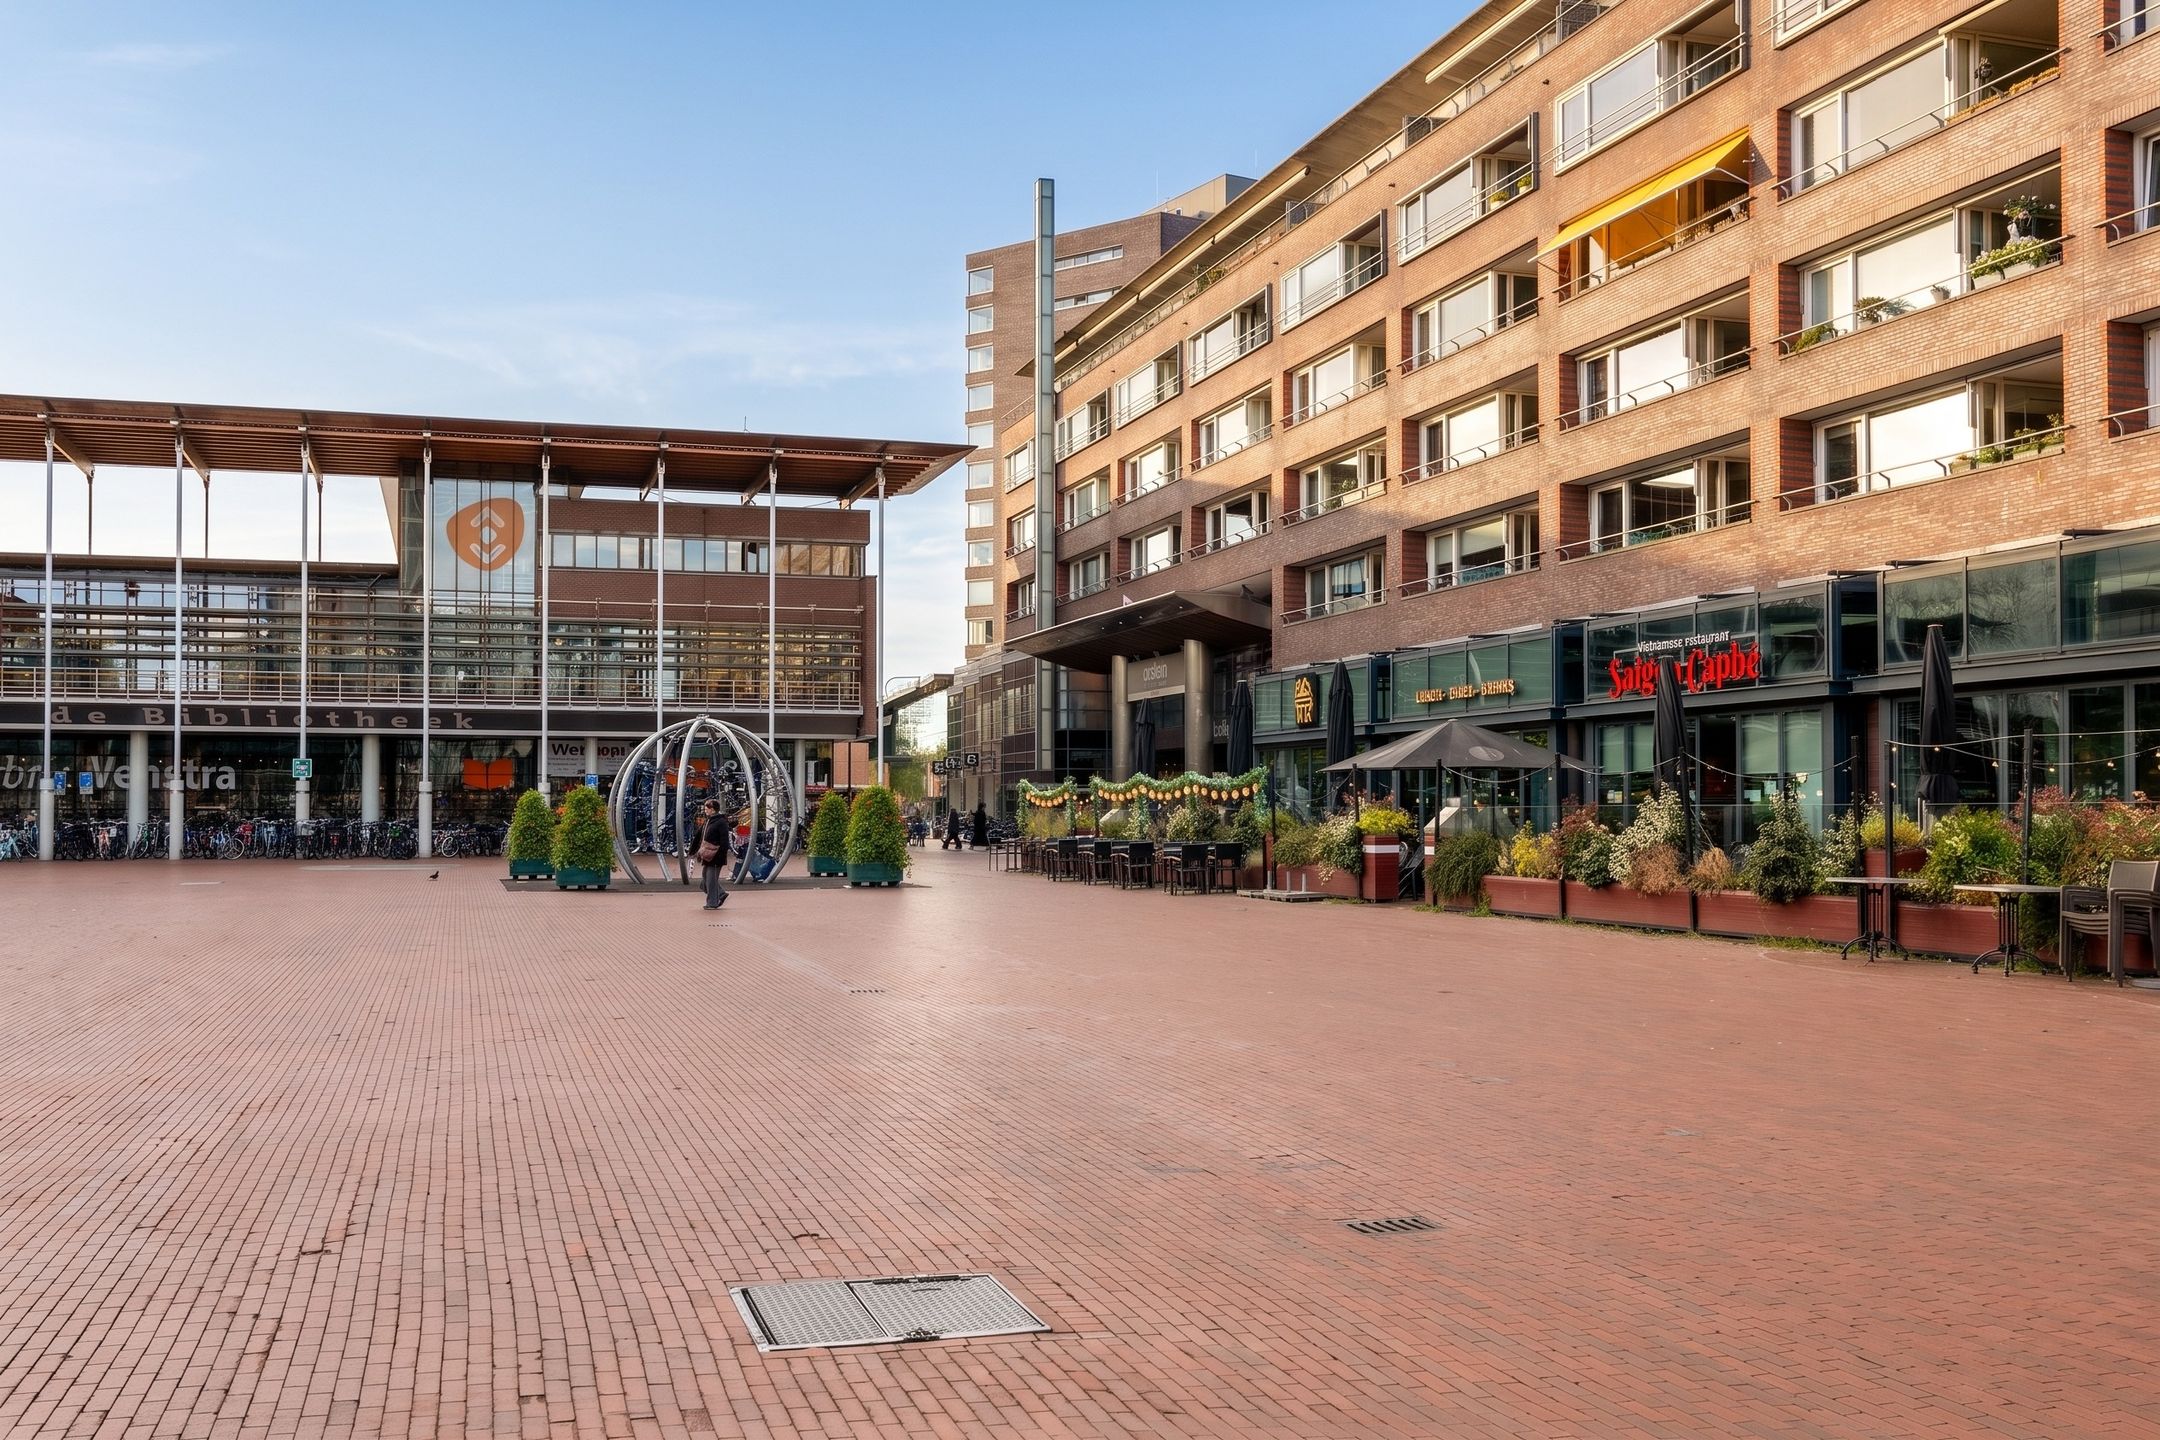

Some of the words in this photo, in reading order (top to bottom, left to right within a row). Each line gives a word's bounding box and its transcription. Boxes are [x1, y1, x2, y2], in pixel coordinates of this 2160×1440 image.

[1608, 656, 1684, 699] Saign
[1687, 640, 1761, 693] Caphé
[51, 705, 107, 724] de
[142, 706, 473, 729] Bibliotheek
